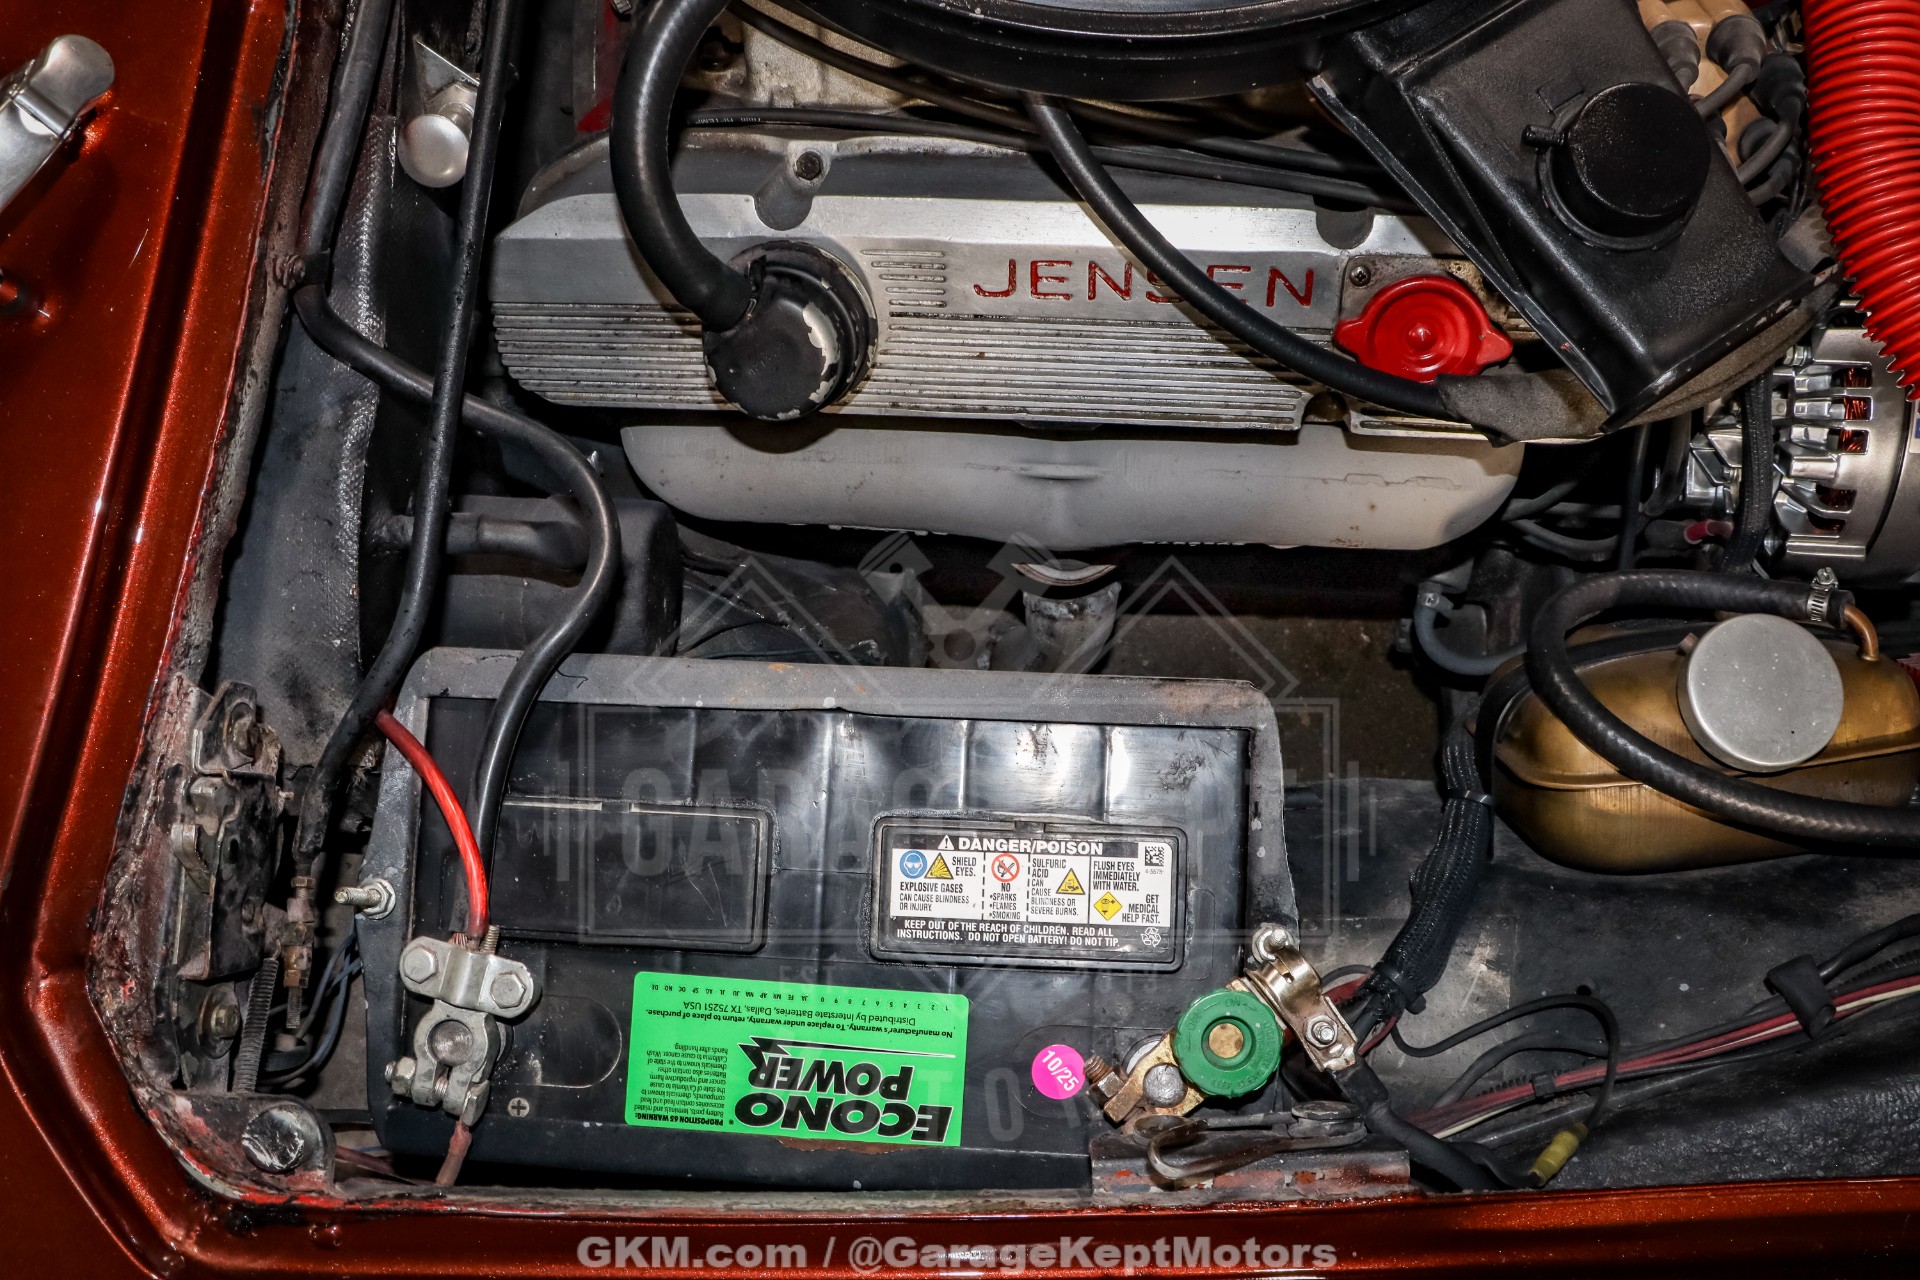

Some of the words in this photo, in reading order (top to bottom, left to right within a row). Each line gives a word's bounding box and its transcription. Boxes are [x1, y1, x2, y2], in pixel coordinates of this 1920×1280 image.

[958, 837, 1103, 855] DANGER/POISON
[952, 856, 977, 867] SHIELD
[1032, 858, 1067, 869] SULFURIC
[1093, 861, 1116, 871] FLUSH
[1117, 861, 1135, 872] EYES
[955, 867, 976, 877] EYES.
[1031, 868, 1049, 878] ACID
[1093, 871, 1141, 882] IMMEDIATELY
[900, 881, 939, 893] EXPLOSIVE
[940, 883, 963, 893] GASES
[1000, 882, 1011, 892] NO
[1031, 878, 1044, 887] CAN
[1093, 881, 1111, 891] WITH
[1113, 882, 1139, 892] WATER.
[1031, 888, 1051, 897] CAUSE
[899, 893, 913, 901] CAN
[913, 894, 934, 902] CAUSE
[935, 895, 970, 904] BLINDNESS
[1030, 897, 1066, 906] BLINDNESS
[1067, 898, 1076, 906] OR
[1145, 894, 1160, 904] GET
[899, 902, 909, 910] OR
[1030, 906, 1055, 915] SEVERE
[1055, 907, 1079, 916] BURNS.
[1128, 903, 1160, 914] MEDICAL
[1121, 913, 1140, 923] HELP
[1141, 913, 1161, 924] FAST.
[904, 920, 926, 929] KEEP
[928, 921, 945, 930] OUT
[948, 921, 959, 931] OF
[960, 922, 977, 931] THE
[978, 923, 1008, 933] REACH
[1010, 924, 1022, 933] OF
[1023, 924, 1070, 936] CHILDREN.
[1072, 926, 1096, 936] READ
[1097, 927, 1113, 937] ALL
[897, 929, 963, 941] INSTRUCTIONS.
[968, 931, 981, 941] DO
[983, 932, 1000, 942] NOT
[1002, 933, 1026, 943] OPEN
[1028, 934, 1067, 945] BATTERY!
[1069, 936, 1083, 945] DO
[1083, 936, 1101, 946] NOT
[1104, 937, 1120, 947] TIP.
[683, 1001, 702, 1010] USA
[704, 1003, 728, 1013] 75251
[730, 1004, 742, 1014] TX
[744, 1005, 772, 1016] Dallas,
[646, 1009, 682, 1018] purchase.
[682, 1012, 690, 1020] of
[692, 1012, 712, 1021] place
[774, 1007, 813, 1018] Batteries,
[814, 1010, 854, 1022] Interstate
[855, 1012, 866, 1023] by
[713, 1014, 721, 1022] to
[746, 1016, 782, 1024] warranty,
[868, 1014, 916, 1026] Distributed
[806, 1020, 834, 1030] replace
[846, 1023, 883, 1033] warranty.
[941, 1031, 953, 1039] No
[738, 1044, 915, 1102] POWER
[1041, 1050, 1080, 1092] 10/25
[664, 1106, 689, 1114] terminals
[706, 1109, 724, 1118] Battery
[680, 1116, 724, 1126] PROPOSITION
[734, 1092, 954, 1143] ECONO
